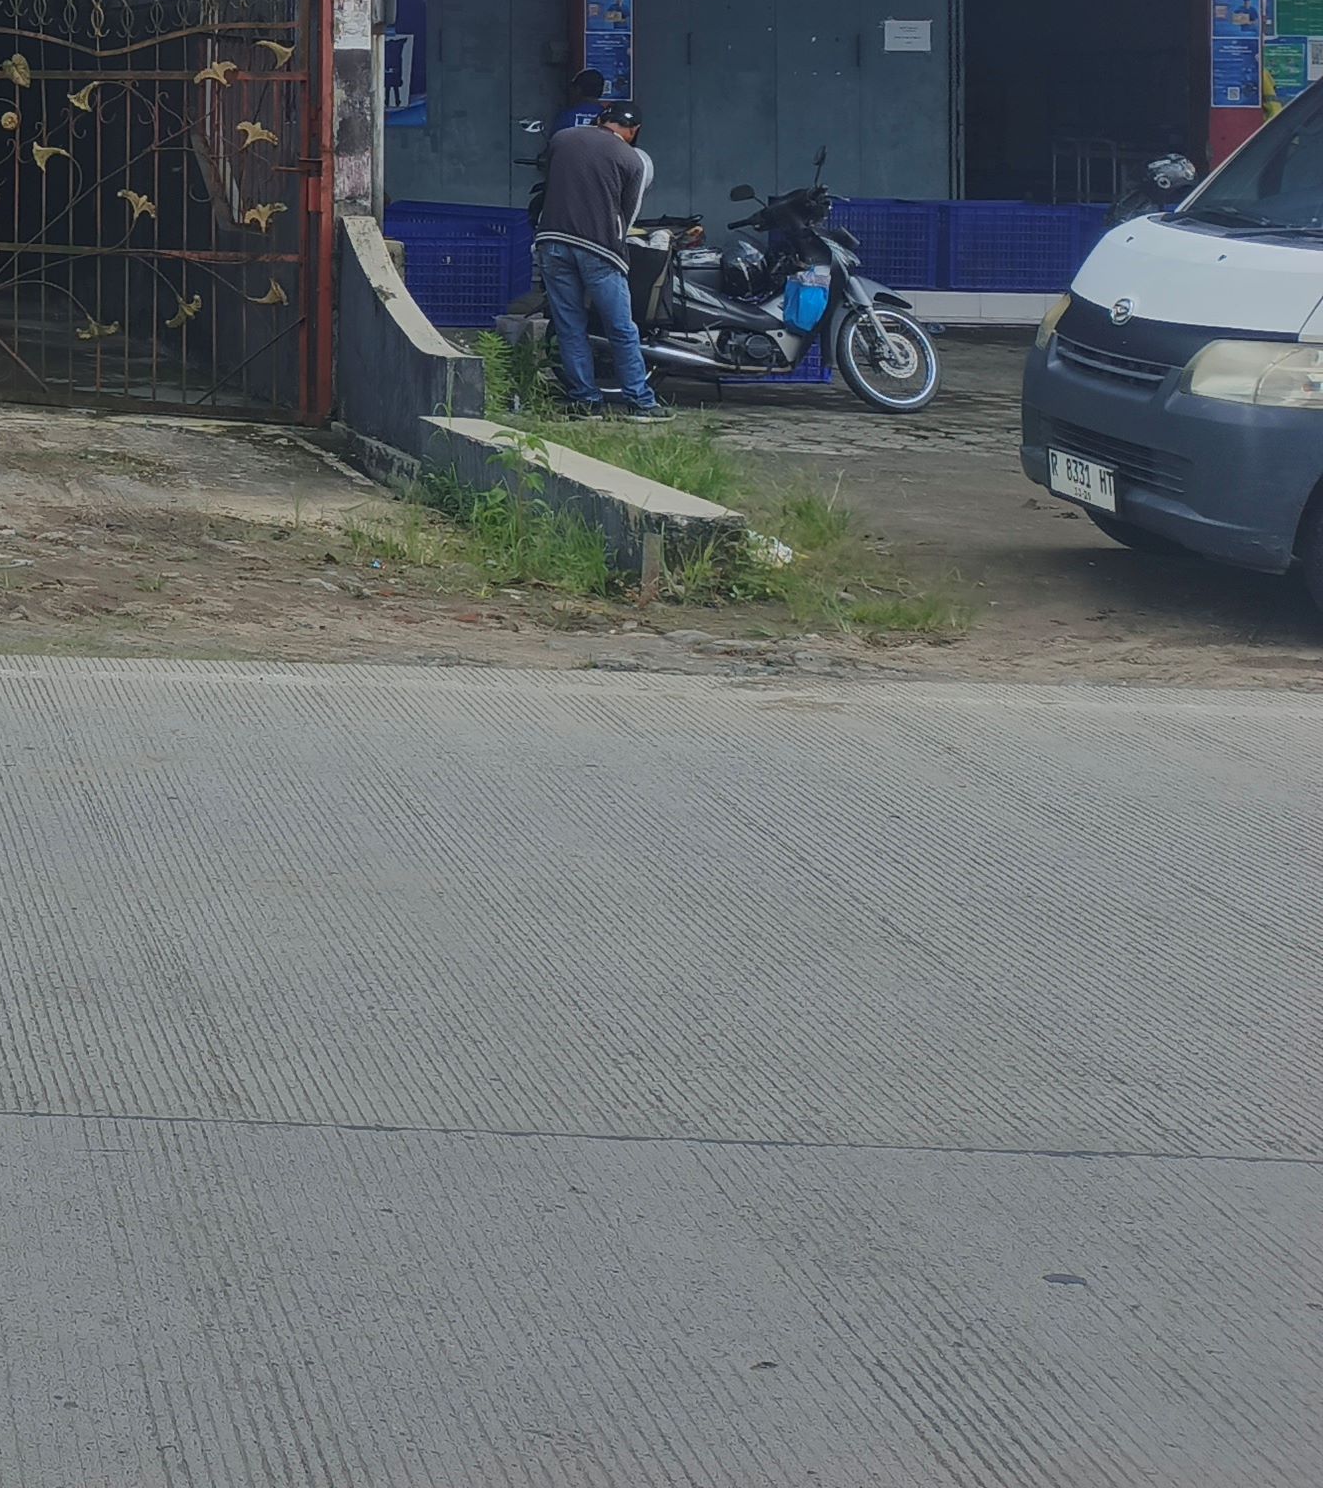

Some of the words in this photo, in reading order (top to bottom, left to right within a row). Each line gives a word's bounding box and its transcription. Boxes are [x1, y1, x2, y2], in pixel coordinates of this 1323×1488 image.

[1050, 452, 1059, 477] R
[1066, 458, 1092, 489] 8331
[1099, 469, 1116, 496] HT
